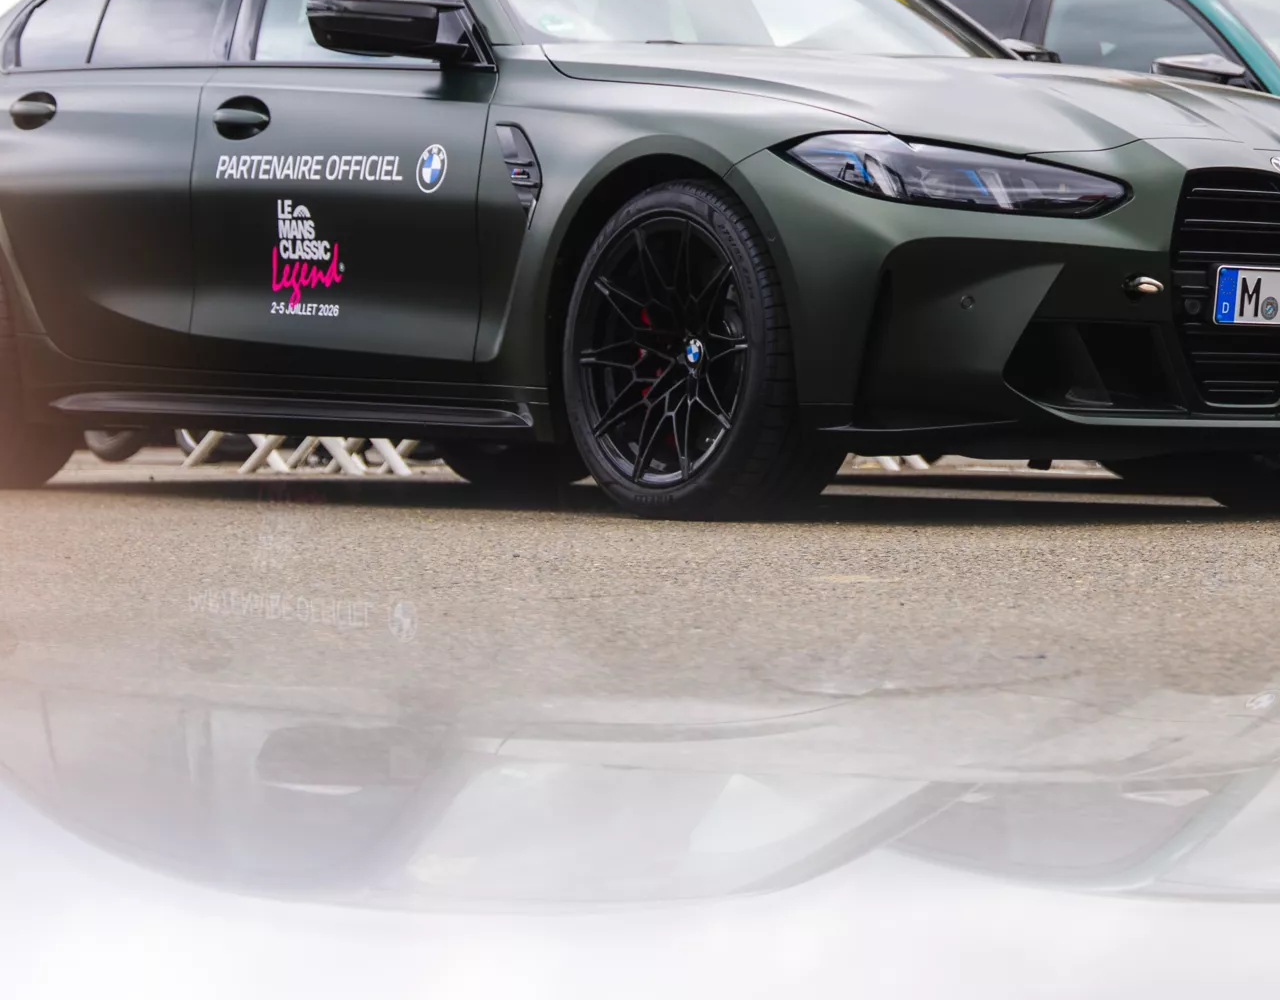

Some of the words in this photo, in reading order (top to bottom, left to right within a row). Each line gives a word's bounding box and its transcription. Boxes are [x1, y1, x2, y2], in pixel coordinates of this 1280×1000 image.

[215, 155, 324, 180] PARTENAIRE
[325, 155, 403, 181] OFFICIEL
[277, 199, 292, 219] LE
[278, 219, 315, 240] MANS
[279, 240, 331, 260] CLASSIC
[1238, 277, 1262, 318] M
[270, 302, 285, 314] 2-5
[285, 303, 317, 315] JUILLET
[318, 304, 339, 316] 2026
